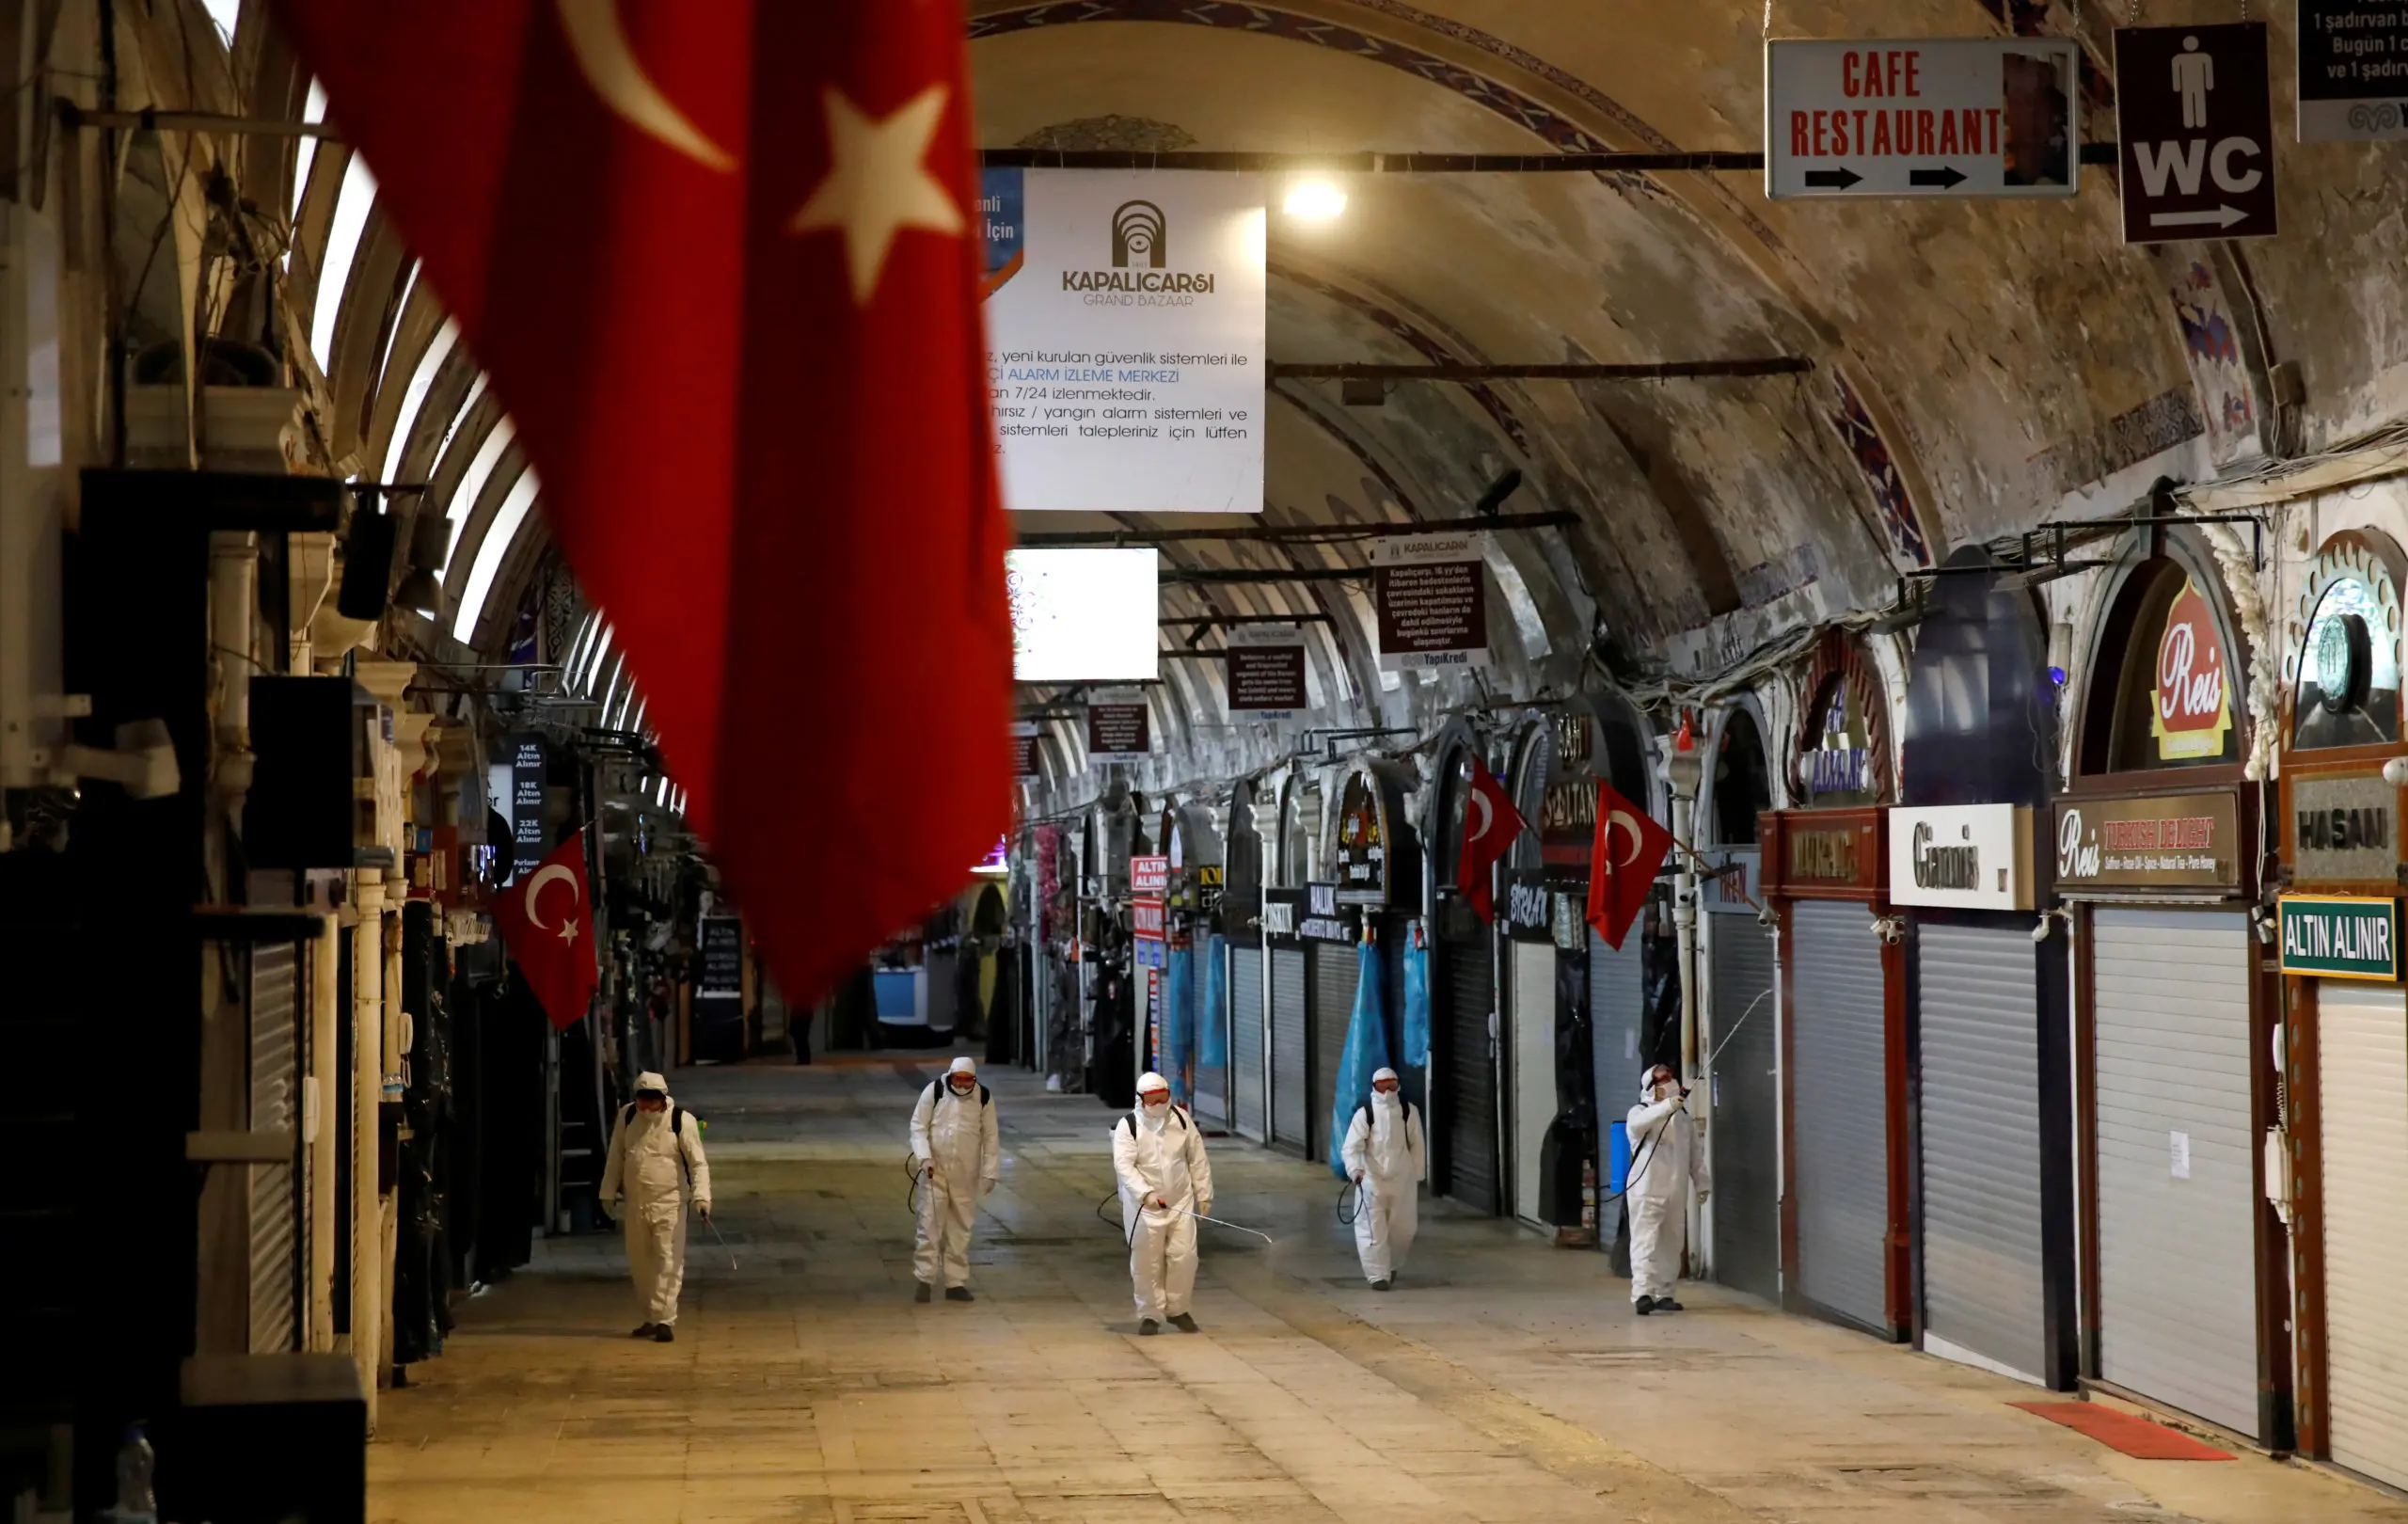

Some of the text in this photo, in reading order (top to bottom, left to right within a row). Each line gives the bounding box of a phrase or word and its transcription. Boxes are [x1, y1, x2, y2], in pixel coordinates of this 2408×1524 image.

[2333, 35, 2384, 56] Bugün
[1843, 51, 1921, 98] CAFE
[2327, 65, 2346, 79] ve
[1791, 108, 2002, 157] RESTAURANT
[2134, 136, 2263, 198] WC
[987, 218, 1014, 242] İçin
[1084, 294, 1194, 307] GRAND BAZAAR
[1002, 351, 1034, 364] yeni
[1038, 351, 1091, 364] kurulan
[1095, 351, 1156, 367] güvenlik
[1160, 352, 1228, 365] sistemleri
[1231, 354, 1247, 366] ile
[1008, 368, 1060, 381] ALARM
[1065, 366, 1113, 382] İZLEME
[1118, 368, 1179, 383] MERKEZİ
[1016, 387, 1047, 400] 7/24
[1053, 387, 1155, 401] izlenmektedir.
[1044, 407, 1096, 421] yangın
[1102, 406, 1148, 419] alarm
[1154, 407, 1222, 421] sistemleri
[1228, 410, 1247, 421] ve
[1000, 423, 1247, 441] sistemleri talepleriniz için lütfen
[2162, 622, 2221, 720] Reis
[2298, 807, 2388, 851] HASAN
[2060, 809, 2100, 878] Reis
[2285, 913, 2390, 961] ALTIN ALINIR
